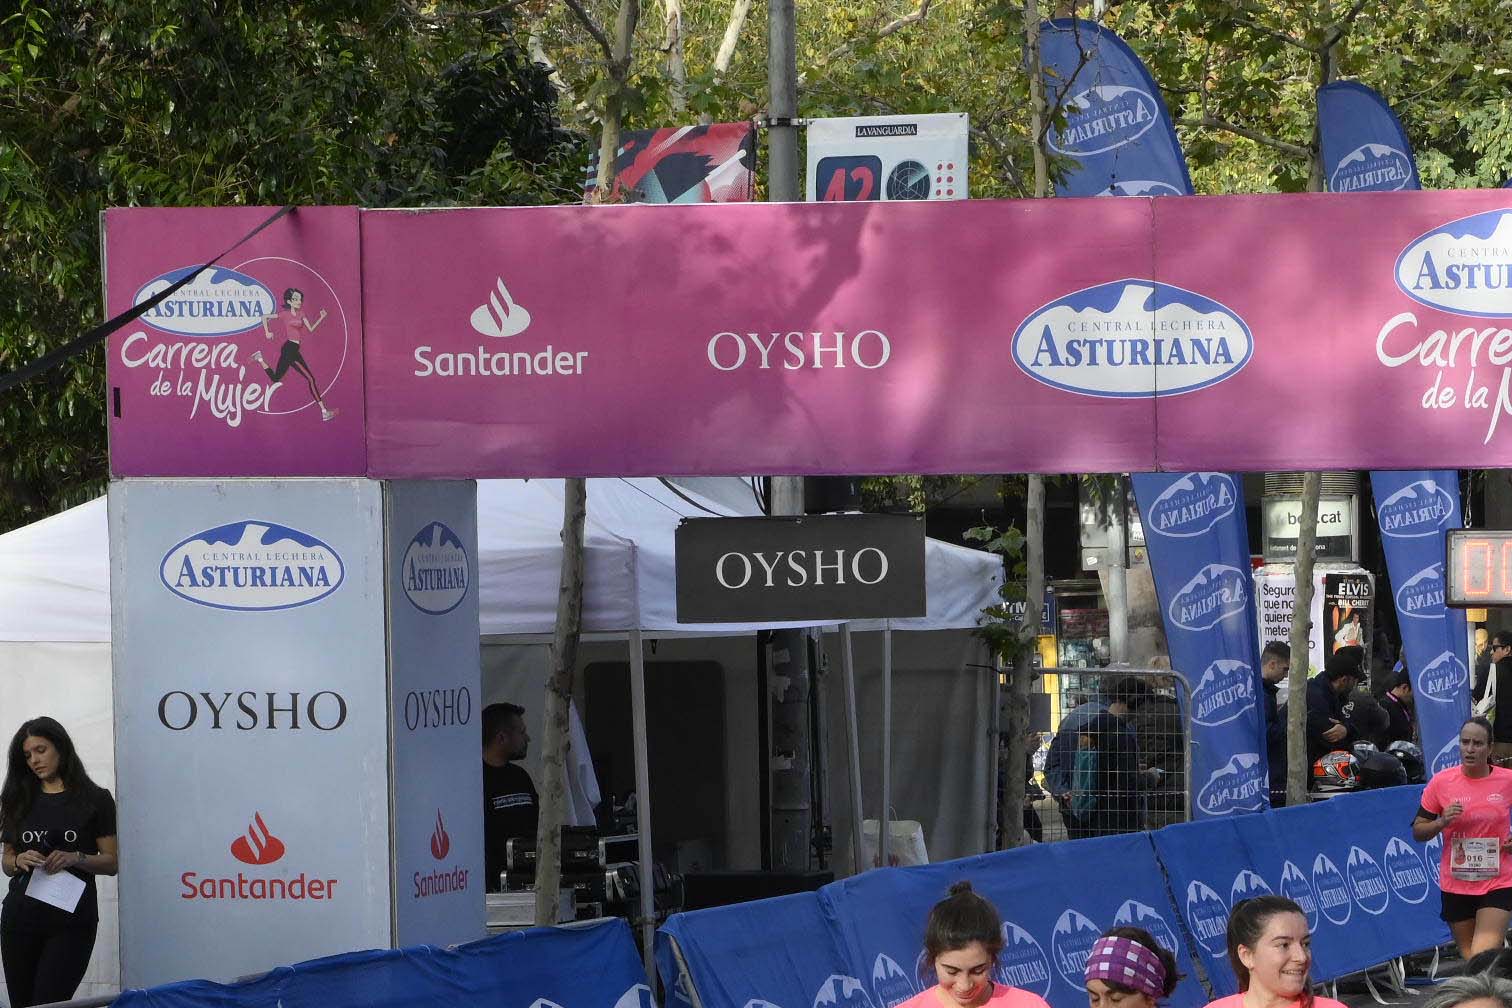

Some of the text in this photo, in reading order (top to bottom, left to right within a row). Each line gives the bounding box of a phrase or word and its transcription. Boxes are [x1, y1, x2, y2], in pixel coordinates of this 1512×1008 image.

[144, 291, 264, 318] ASTURIANA
[173, 289, 211, 297] ENTRAL
[1067, 320, 1227, 333] CENTRAL LECHERA
[121, 331, 239, 368] Carrera
[414, 345, 588, 376] Santander
[707, 330, 891, 372] OYSHO
[1031, 324, 1234, 368] ASTURIANA
[150, 366, 284, 428] de la Mujer
[1422, 370, 1456, 409] de
[1464, 368, 1489, 409] la
[175, 555, 332, 588] ASTURIANA
[203, 552, 325, 562] CENTRAL LECHERA
[716, 547, 889, 589] OYSHO
[407, 556, 466, 592] ASTURIANA
[1338, 582, 1369, 595] ELVIS
[1264, 599, 1280, 613] que
[1264, 611, 1294, 626] quiere
[158, 691, 347, 731] OYSHO
[405, 686, 471, 731] OYSHO
[22, 830, 77, 843] OYO
[181, 871, 337, 900] Santander
[414, 865, 469, 898] Santander
